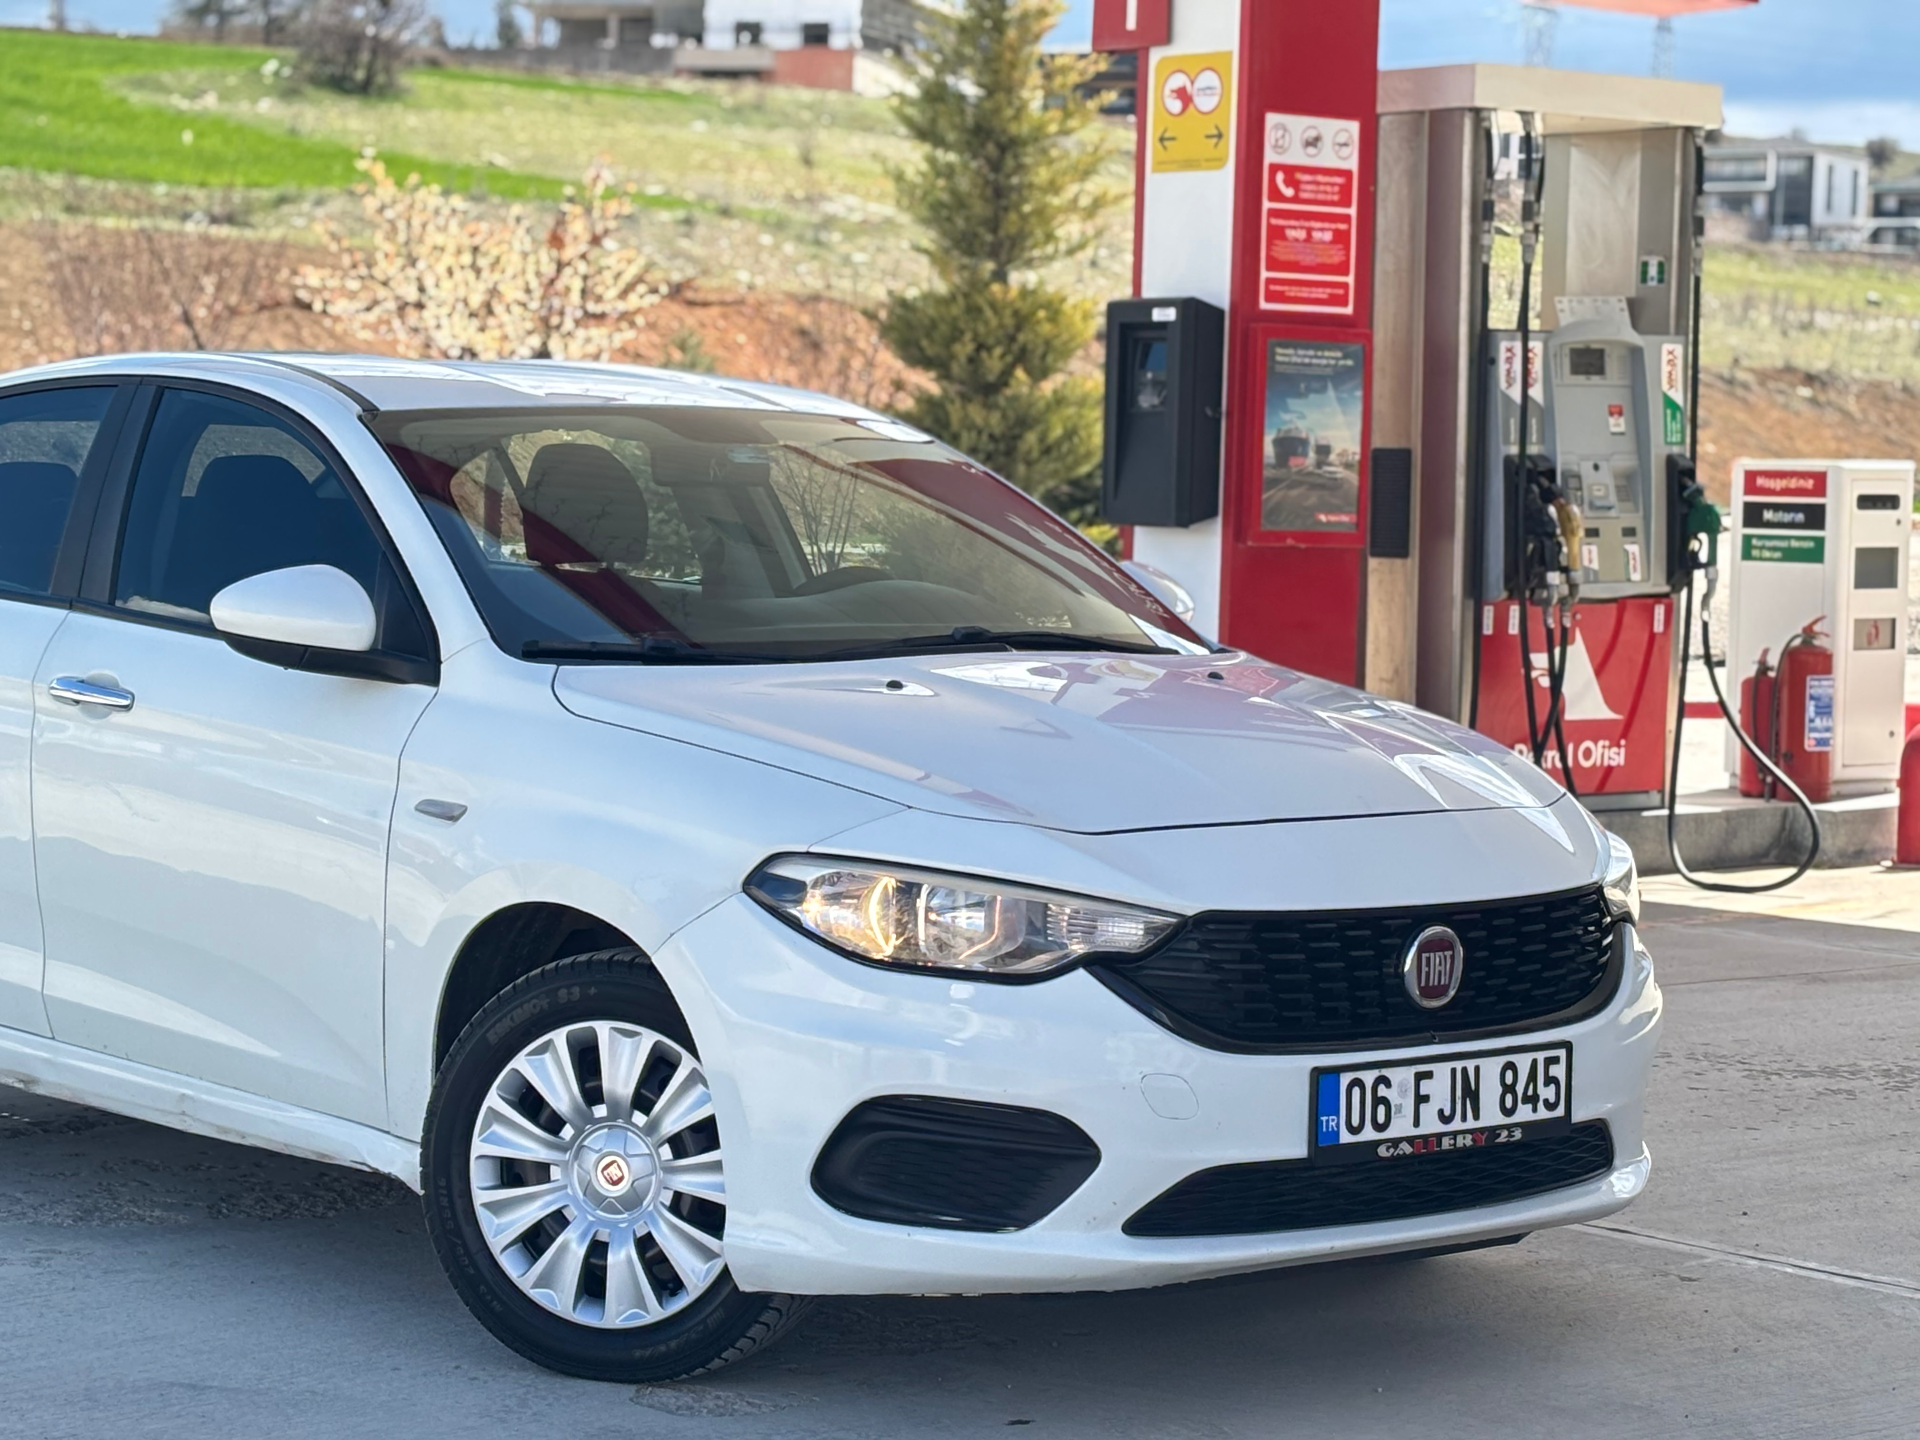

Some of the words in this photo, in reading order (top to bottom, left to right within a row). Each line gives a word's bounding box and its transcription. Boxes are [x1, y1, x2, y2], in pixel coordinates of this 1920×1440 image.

[1578, 739, 1626, 768] Ofisi
[1420, 950, 1453, 987] FIAT
[1345, 1074, 1392, 1136] 06
[1412, 1065, 1481, 1129] FJN
[1499, 1055, 1562, 1118] 845
[1320, 1115, 1338, 1132] TR
[1377, 1131, 1489, 1158] GALLERY
[1495, 1127, 1523, 1144] 23
